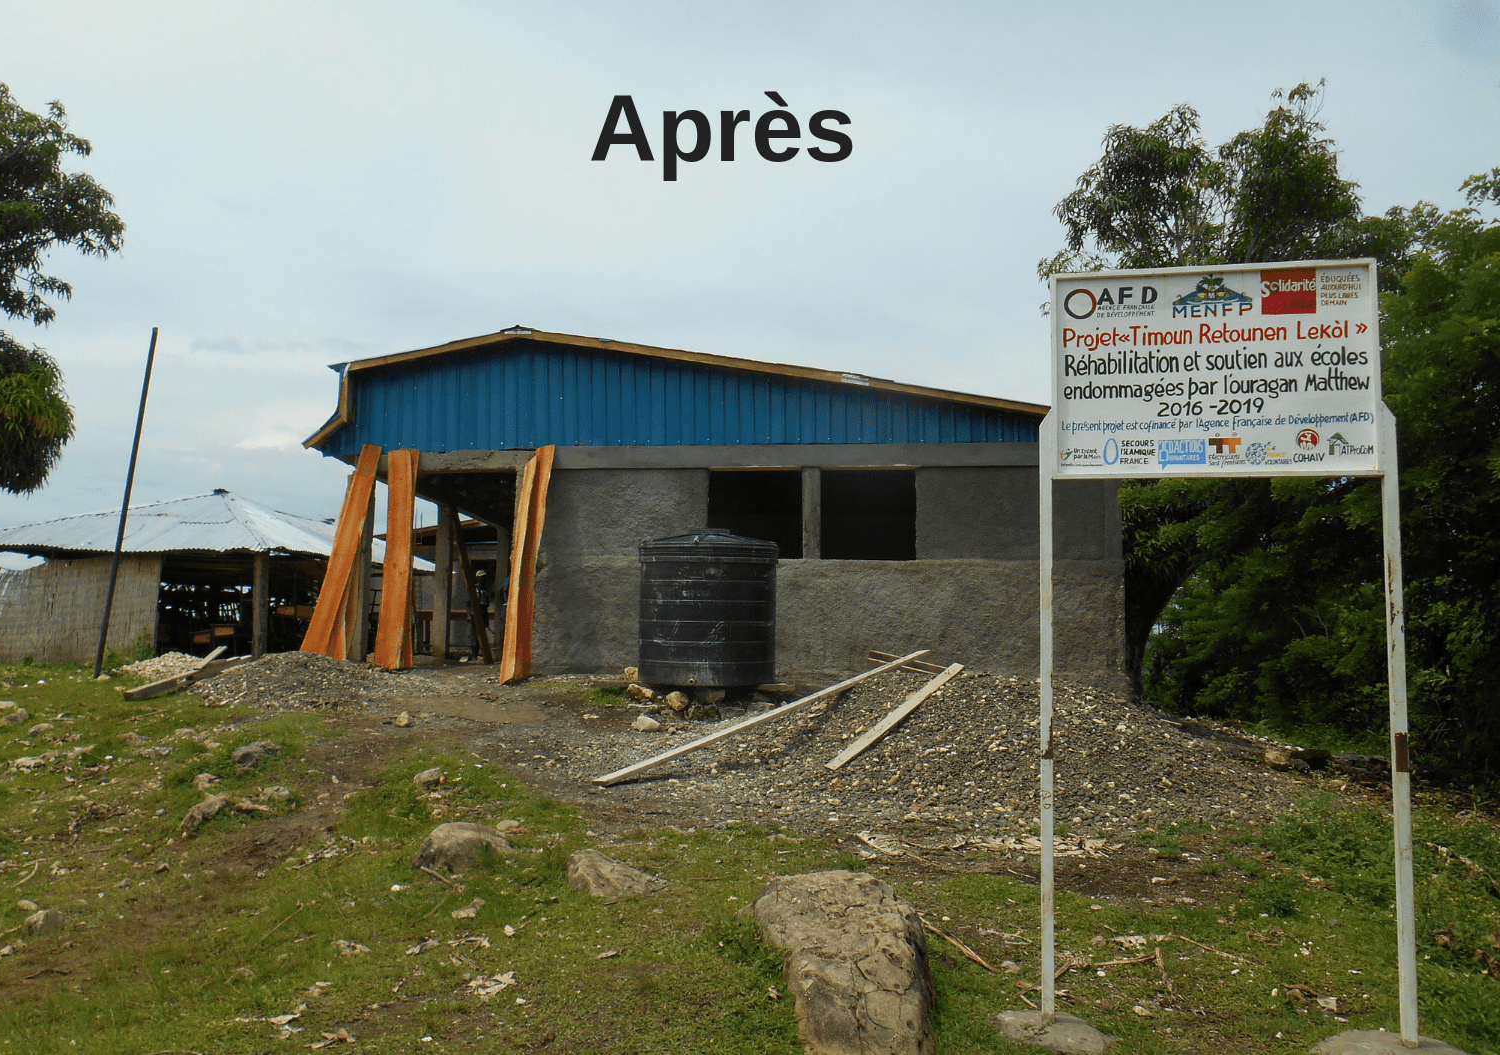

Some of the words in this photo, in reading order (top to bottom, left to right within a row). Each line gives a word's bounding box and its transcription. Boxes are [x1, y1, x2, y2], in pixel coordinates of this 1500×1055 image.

[1097, 286, 1158, 305] AFD
[1261, 278, 1316, 298] Solidarité
[1123, 303, 1155, 311] FRANÇAISE
[1172, 302, 1253, 318] MENFP
[1199, 323, 1287, 344] Retounen
[1065, 349, 1179, 377] Réhabilitation
[1184, 351, 1200, 371] et
[1206, 347, 1267, 371] soutien
[1274, 350, 1304, 368] aux
[1311, 343, 1368, 366] écoles
[1064, 378, 1184, 402] endommagées
[1188, 376, 1219, 400] par
[1224, 373, 1297, 399] l'ouragan
[1305, 367, 1370, 391] Matthew
[1157, 401, 1203, 417] 2016
[1061, 421, 1071, 431] Le
[1072, 420, 1101, 434] présent
[1103, 420, 1124, 434] projet
[1125, 421, 1138, 431] est
[1139, 418, 1176, 432] cofinancé
[1179, 419, 1193, 432] par
[1195, 417, 1229, 431] l'Agence
[1232, 415, 1272, 430] Française
[1275, 414, 1286, 425] de
[1120, 448, 1156, 456] ISLAMIQUE
[1293, 452, 1325, 463] COHAIV
[1120, 457, 1149, 465] FRANCE
